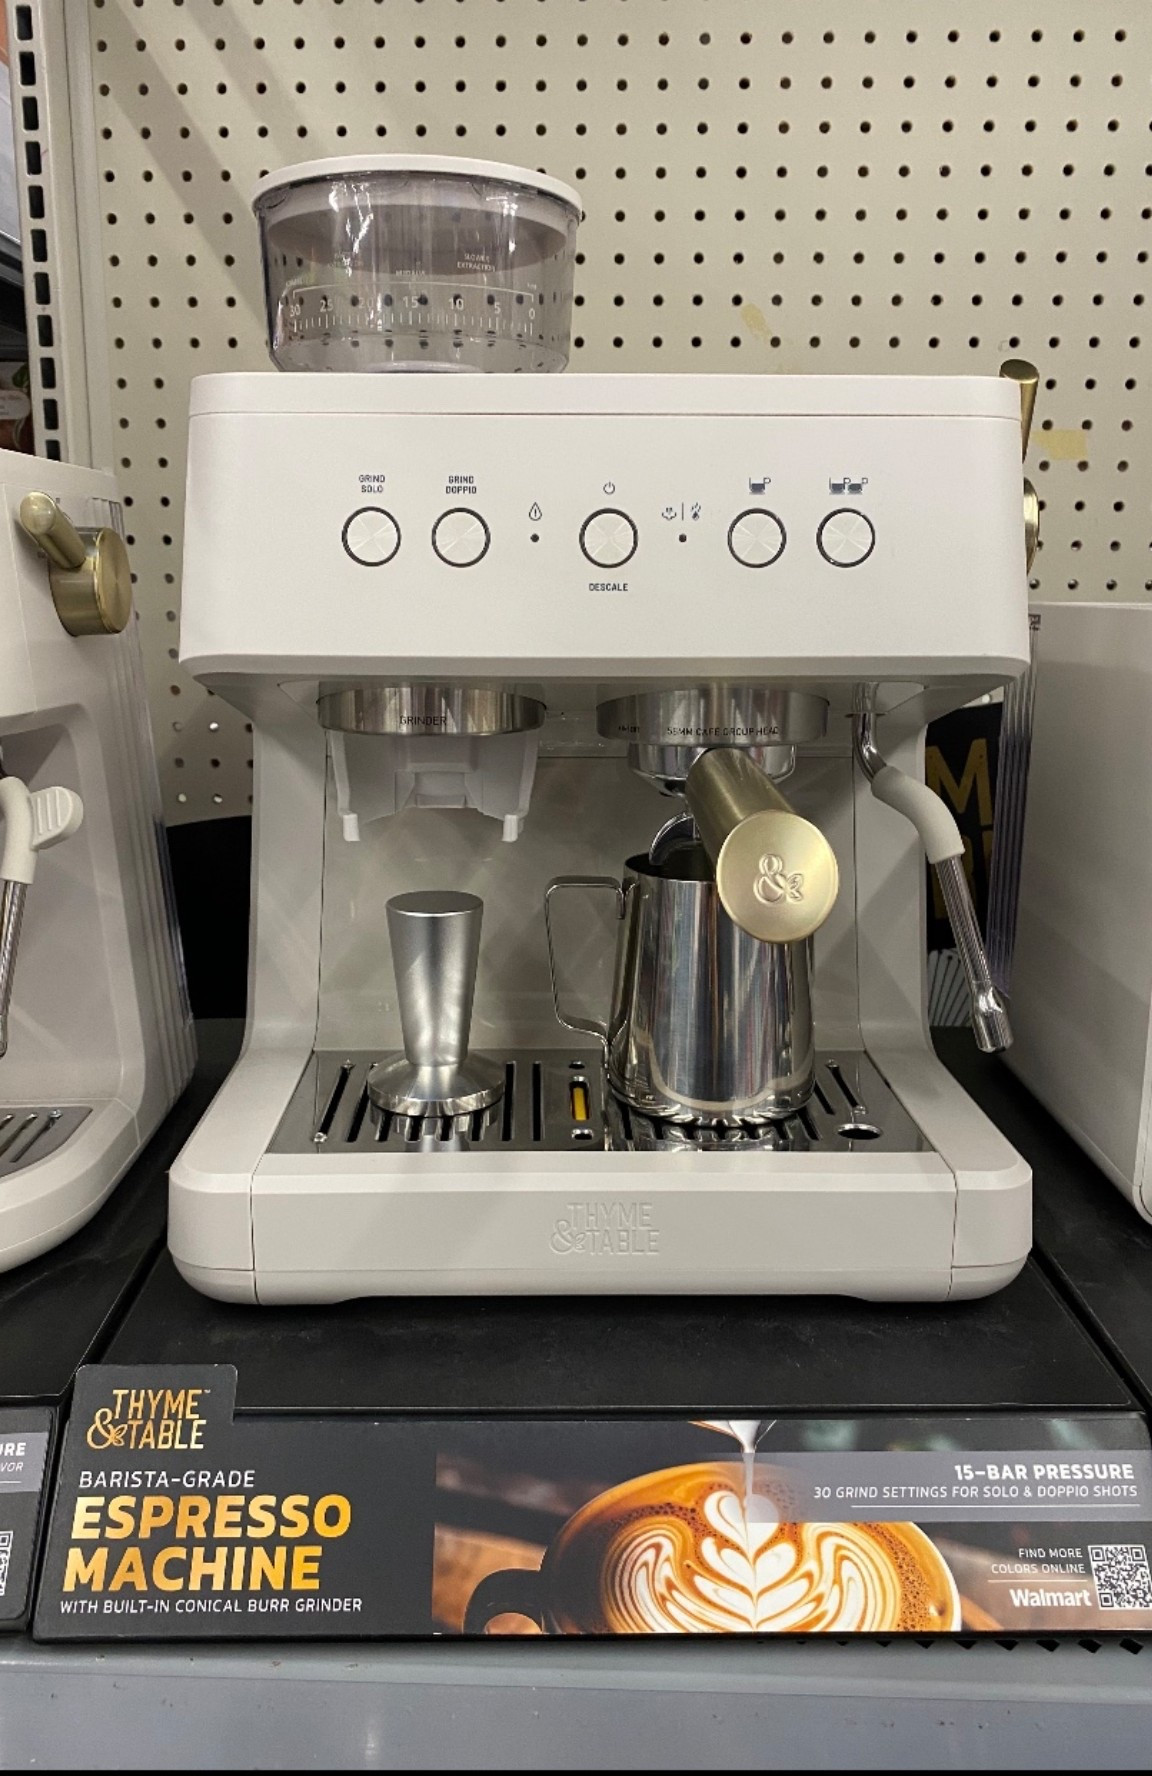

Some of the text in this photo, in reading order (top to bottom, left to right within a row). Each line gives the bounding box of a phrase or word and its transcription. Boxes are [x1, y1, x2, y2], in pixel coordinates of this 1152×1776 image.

[290, 305, 301, 317] 30
[320, 299, 334, 312] 25
[403, 295, 419, 308] 15
[449, 298, 465, 310] 10
[494, 302, 502, 314] 5
[528, 308, 536, 320] 0
[358, 474, 386, 483] GRIND
[448, 475, 475, 484] GRIND
[361, 484, 384, 493] SOLO
[445, 485, 477, 494] DOPPIO
[588, 583, 628, 591] DESCALE
[399, 715, 448, 726] GRINDER
[723, 727, 755, 736] GROUP
[567, 1202, 653, 1230] THYME
[585, 1229, 660, 1255] TABLE
[112, 1389, 202, 1420] THYME
[127, 1419, 207, 1450] TABLE
[79, 1470, 256, 1489] BARISTA-GRADE
[954, 1464, 1134, 1480] 15-BAR PRESSURE
[814, 1485, 1137, 1499] 30 GRIND SETTINGS FOR SOLO & DOPPIO SHOTS
[71, 1494, 352, 1540] ESPRESSO
[1018, 1548, 1083, 1558] FIND MORE
[62, 1545, 323, 1592] MACHINE
[991, 1564, 1086, 1574] COLORS ONLINE
[1009, 1588, 1092, 1607] Walmart
[60, 1598, 362, 1614] WITH BUILT-IN CONICAL BURR GRINDER
